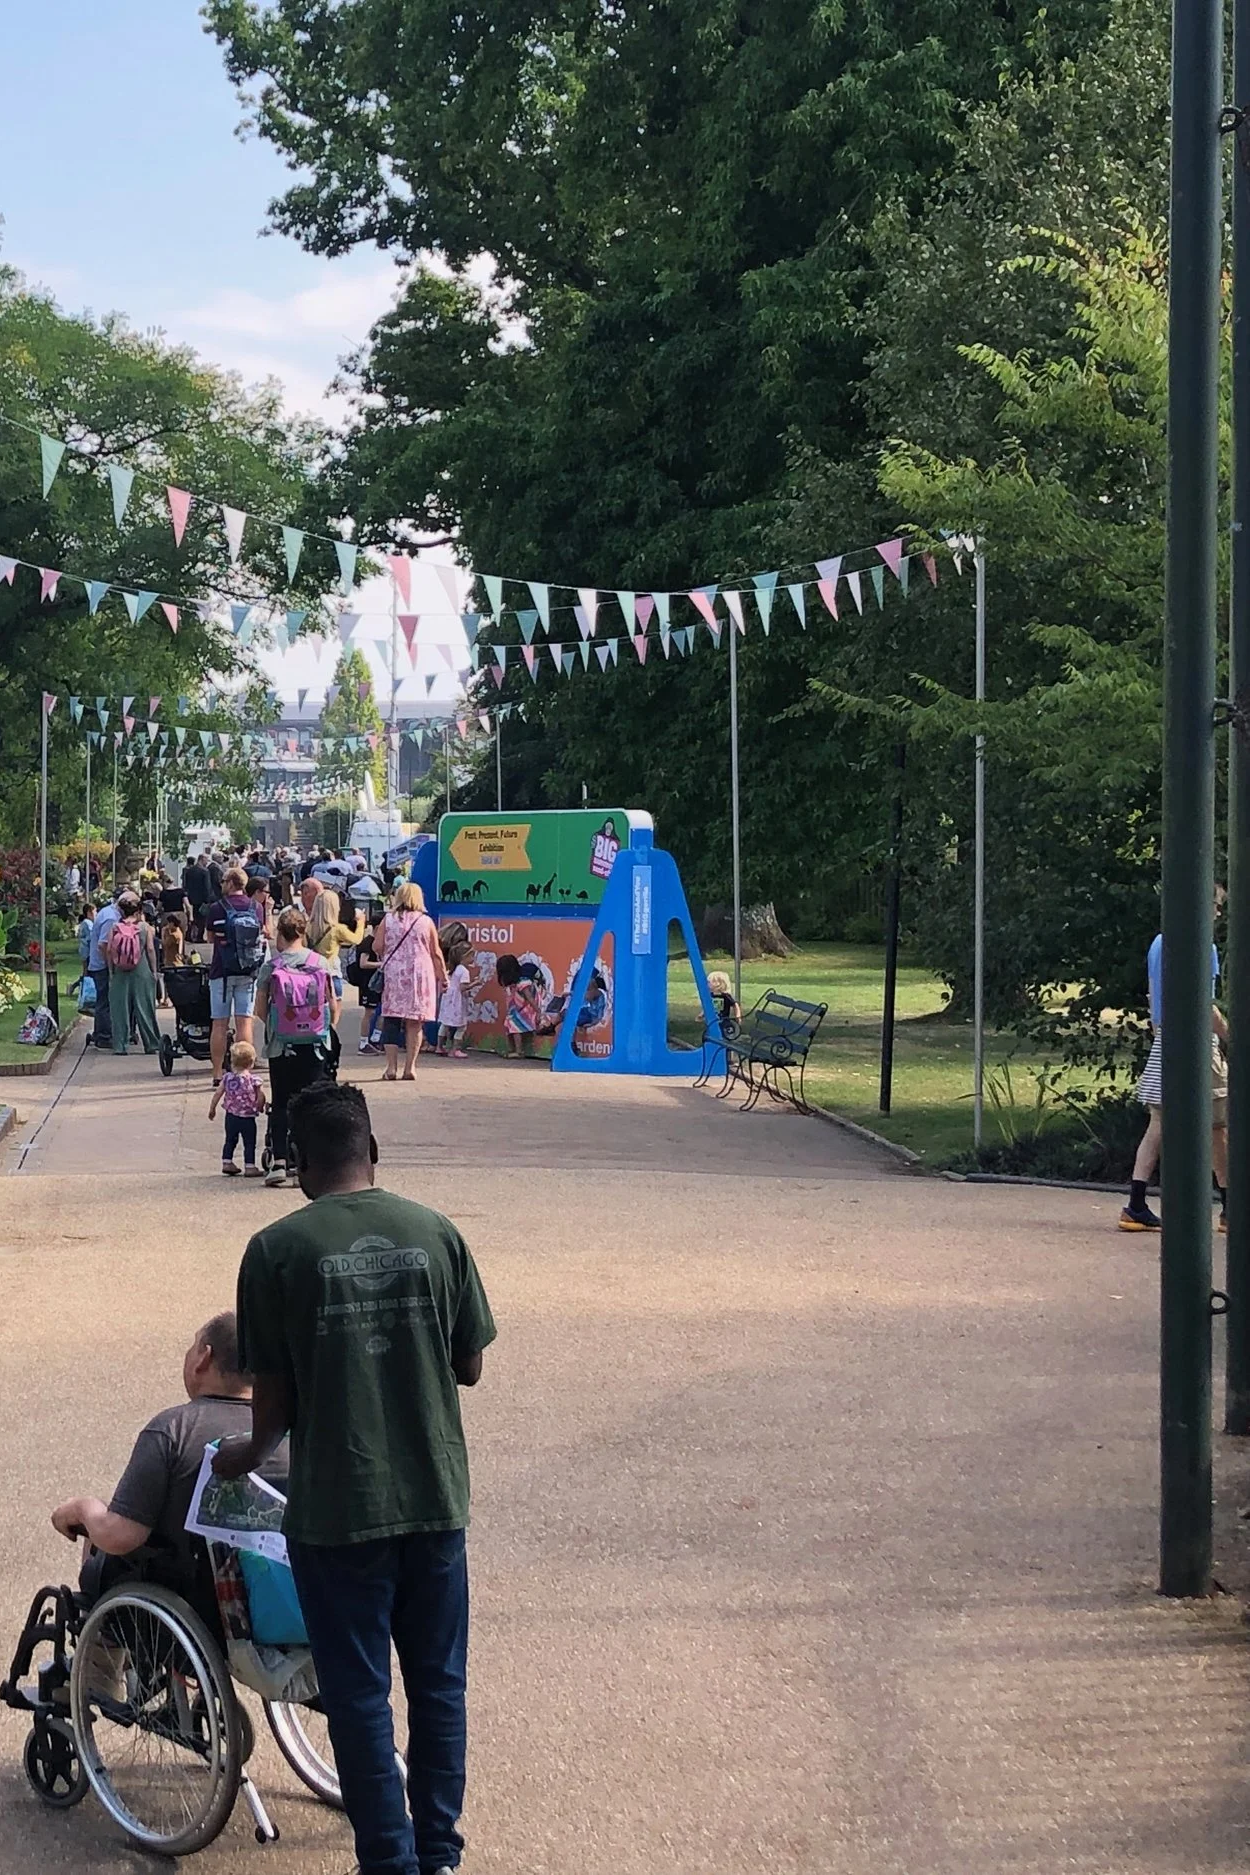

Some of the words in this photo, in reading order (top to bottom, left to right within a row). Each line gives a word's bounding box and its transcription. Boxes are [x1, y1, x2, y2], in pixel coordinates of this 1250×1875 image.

[594, 834, 619, 863] BIG
[461, 922, 514, 943] ristol
[576, 1039, 613, 1054] arden
[320, 1258, 350, 1274] OLD
[353, 1251, 428, 1272] CHICAGO
